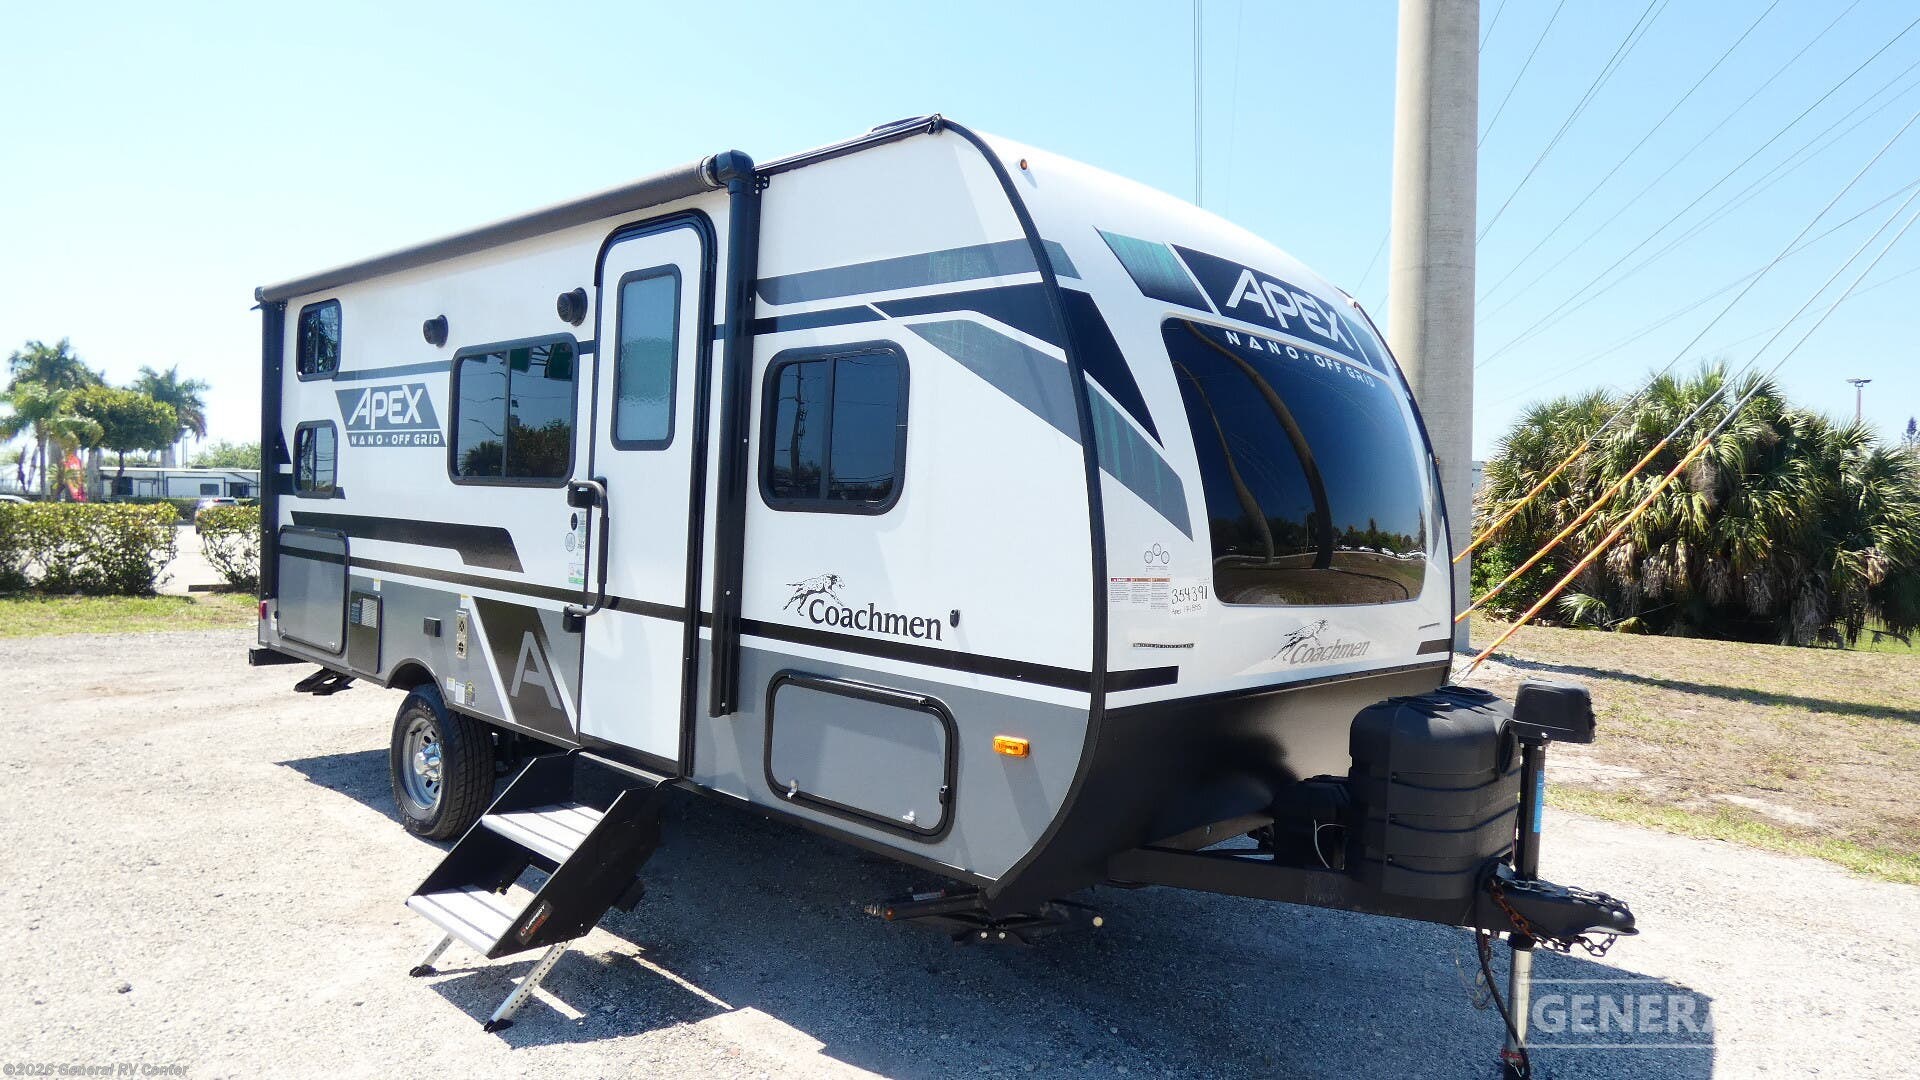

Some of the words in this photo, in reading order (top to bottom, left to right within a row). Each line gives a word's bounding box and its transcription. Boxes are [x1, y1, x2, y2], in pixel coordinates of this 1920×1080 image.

[1226, 269, 1354, 350] APEX
[1225, 330, 1299, 360] NANO
[1313, 354, 1342, 373] OFF
[1346, 366, 1376, 388] GRID
[348, 385, 424, 430] APEX
[351, 434, 383, 445] NANO
[391, 434, 411, 445] OFF
[413, 433, 440, 445] GRID
[1171, 585, 1208, 605] 354391
[808, 598, 943, 642] Coachmen
[510, 630, 562, 710] A
[1289, 638, 1371, 665] Coachmen
